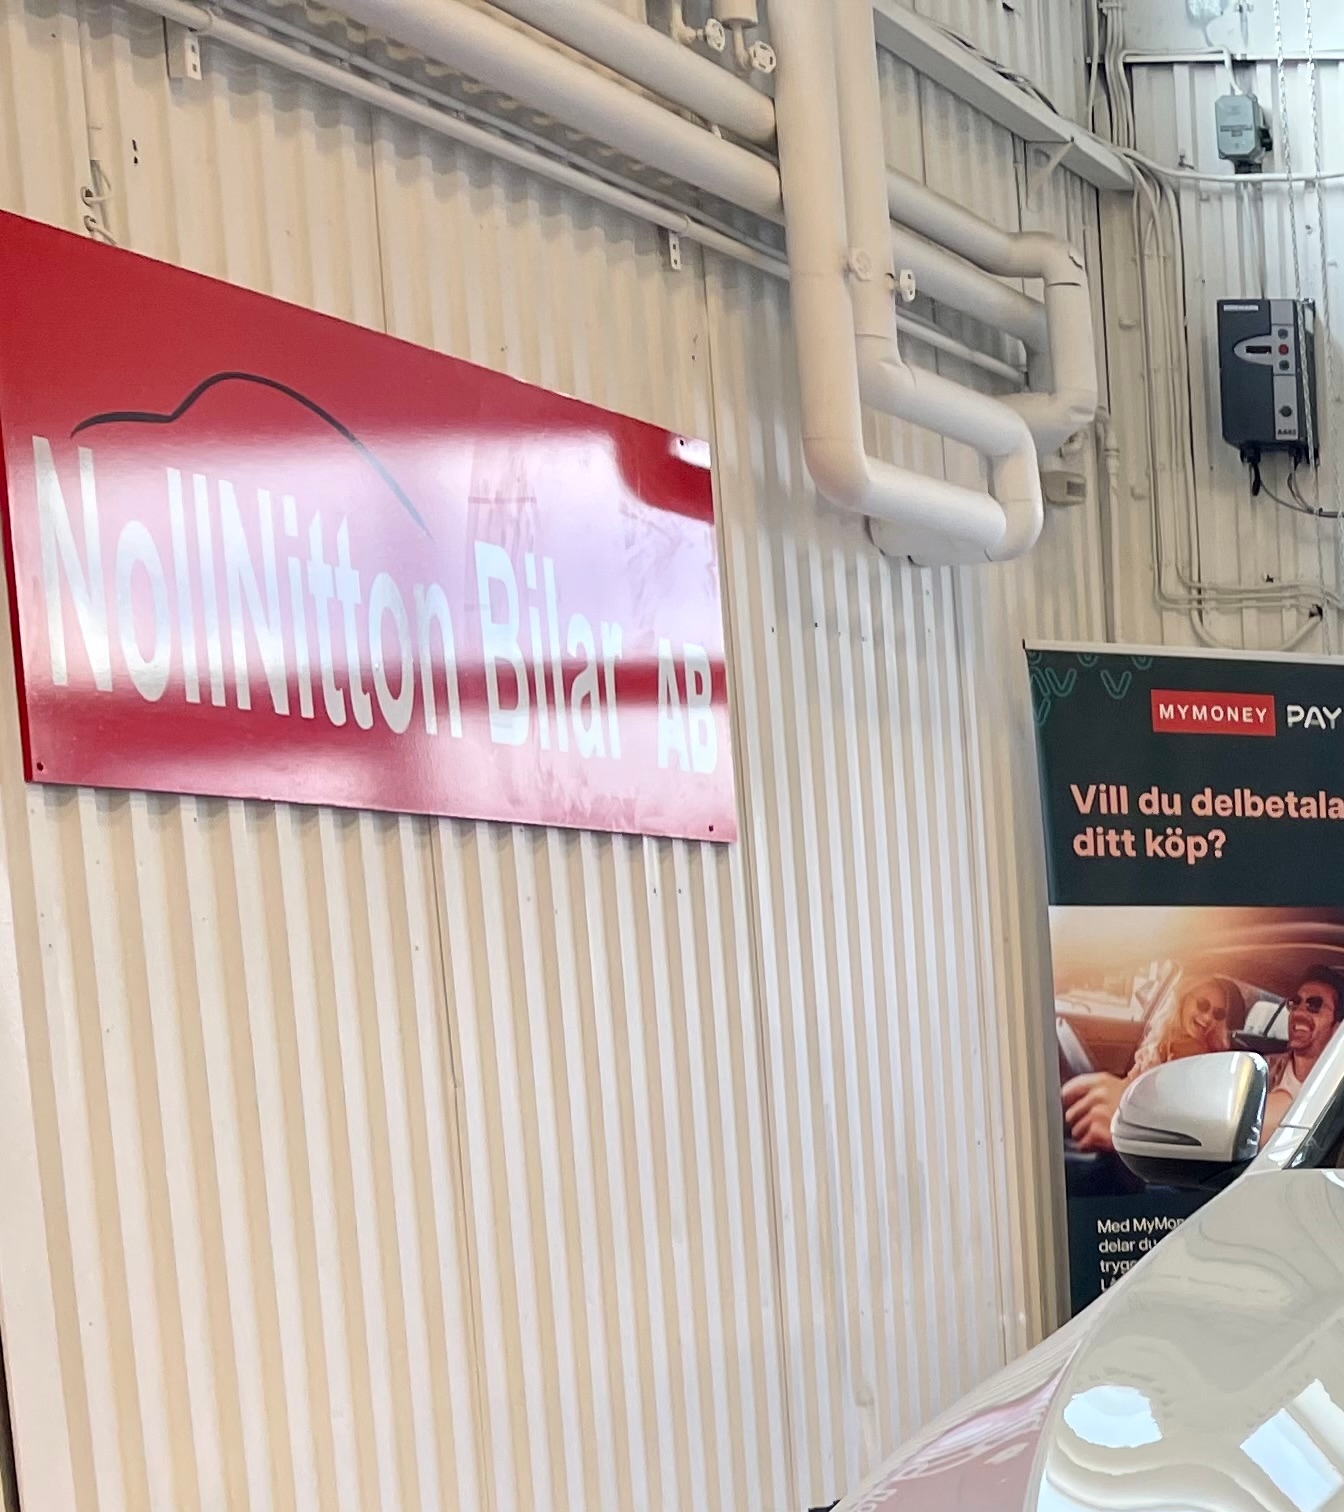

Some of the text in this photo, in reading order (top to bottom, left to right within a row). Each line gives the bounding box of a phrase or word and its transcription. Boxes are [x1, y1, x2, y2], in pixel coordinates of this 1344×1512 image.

[32, 436, 718, 774] NollNitton Bilar AB
[1158, 703, 1342, 729] MYMONEY PAY
[1070, 784, 1129, 815] Vill
[1138, 786, 1182, 816] du
[1072, 827, 1227, 865] ditt köp?
[1097, 1218, 1130, 1234] Med
